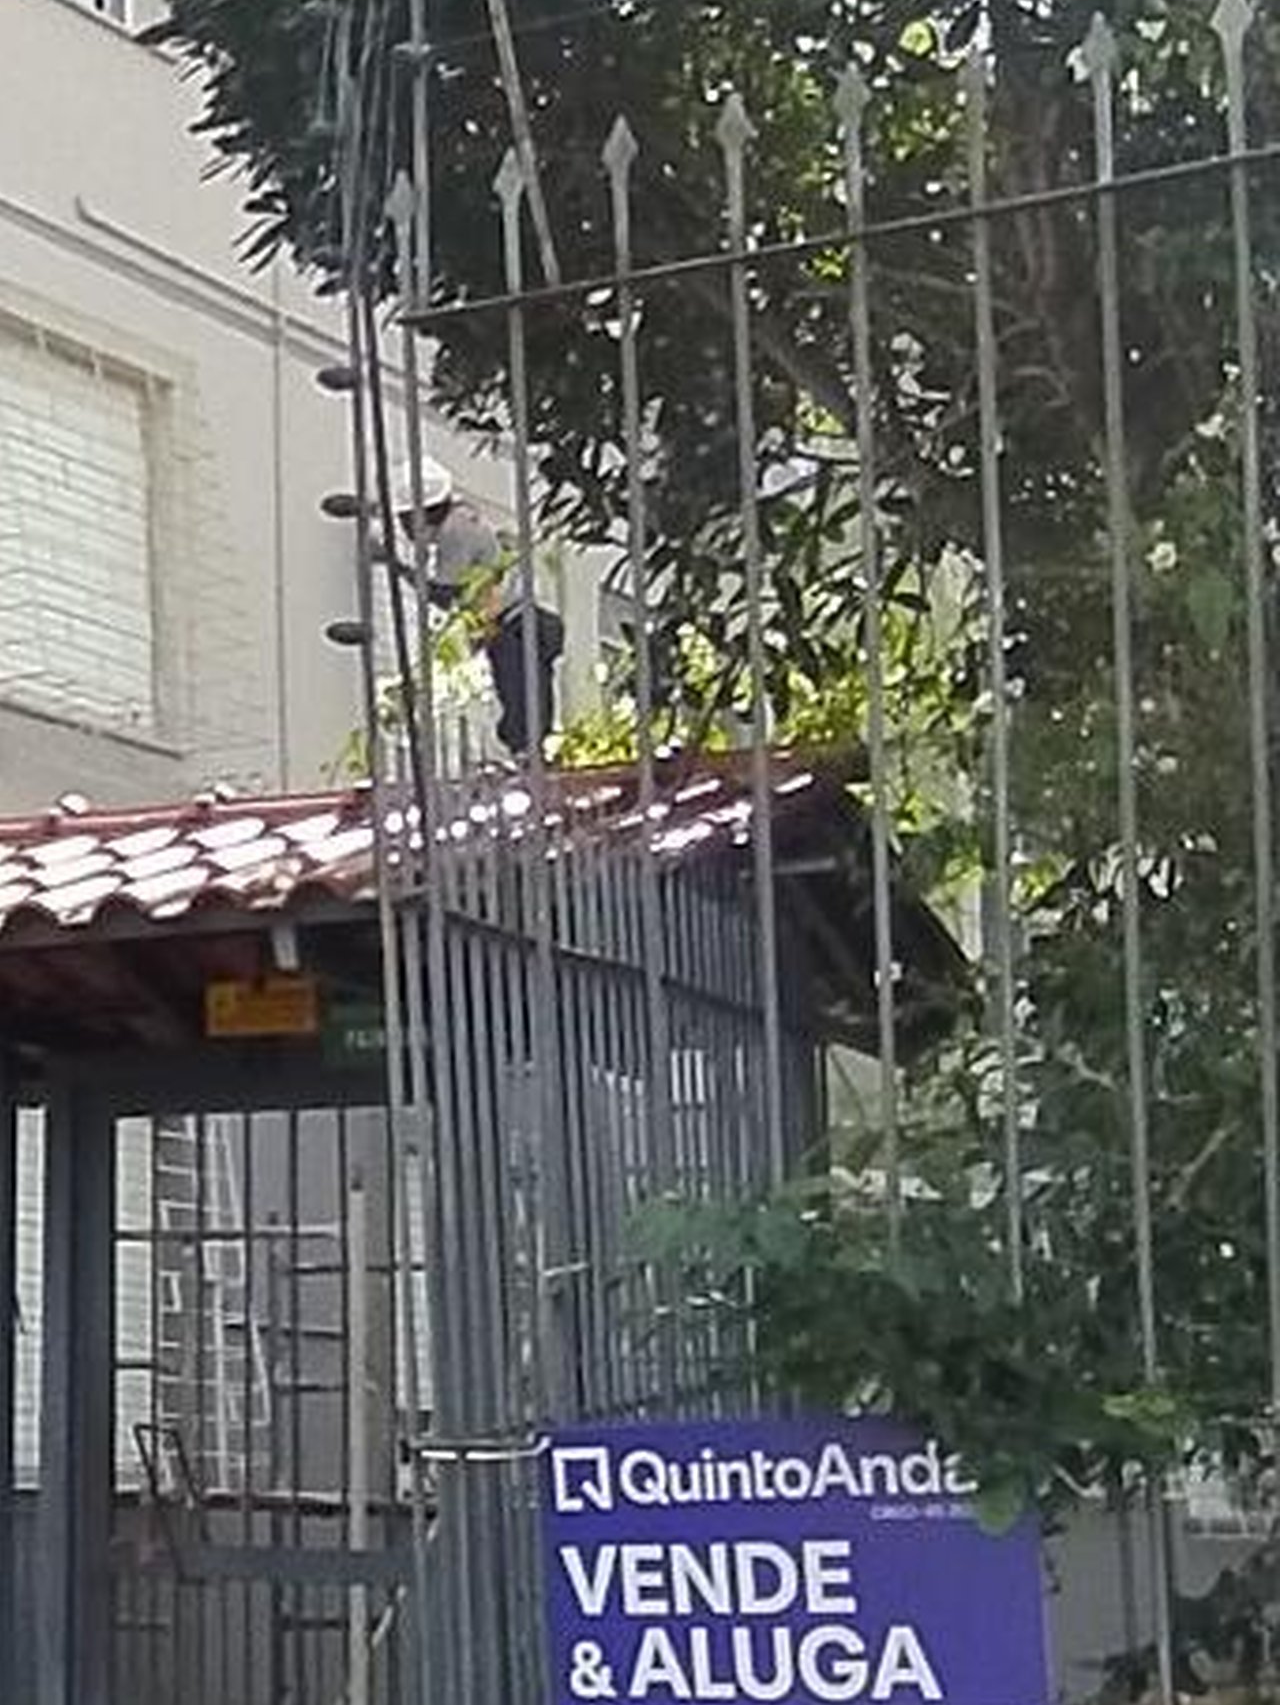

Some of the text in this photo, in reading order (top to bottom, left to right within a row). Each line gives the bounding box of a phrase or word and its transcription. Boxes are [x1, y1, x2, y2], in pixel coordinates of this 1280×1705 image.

[619, 1439, 979, 1505] QuintoAnda
[560, 1540, 857, 1616] VENDE
[569, 1625, 943, 1701] & ALUGA
